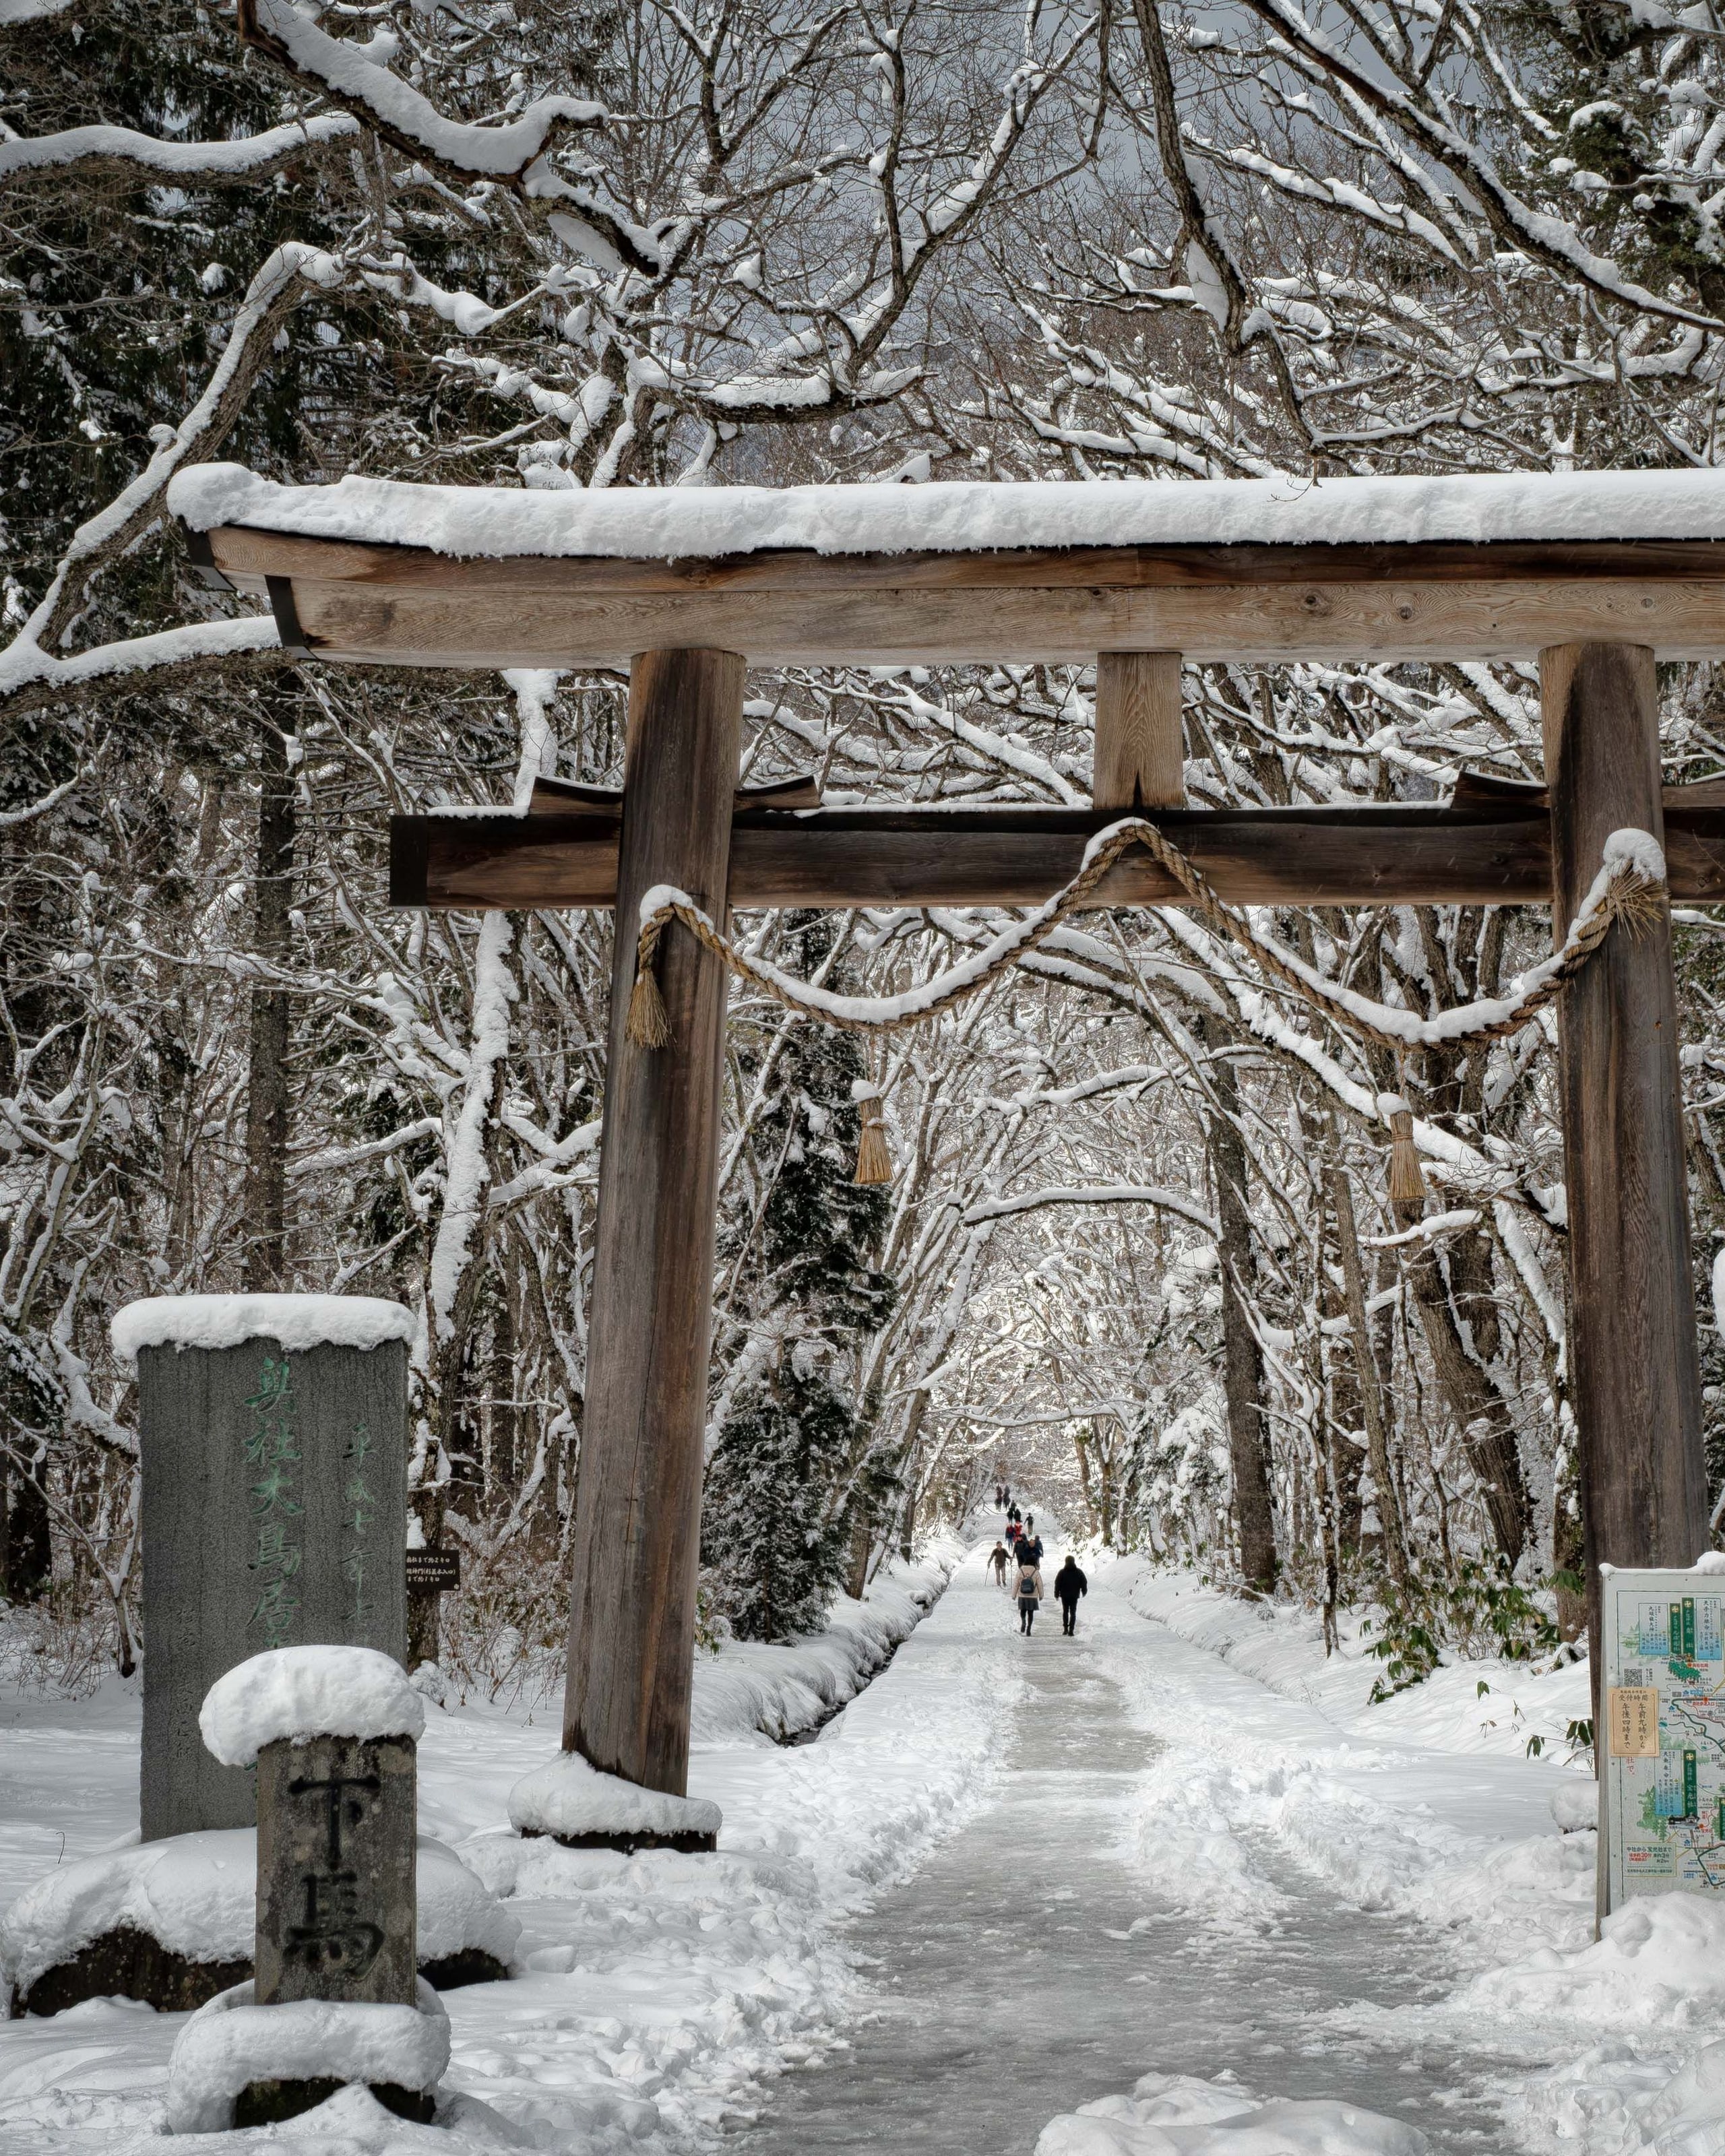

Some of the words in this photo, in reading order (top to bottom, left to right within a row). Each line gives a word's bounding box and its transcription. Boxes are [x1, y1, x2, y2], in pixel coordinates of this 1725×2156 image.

[1622, 1703, 1631, 1749] 午後四時まで
[1638, 1703, 1647, 1749] 午前九時から
